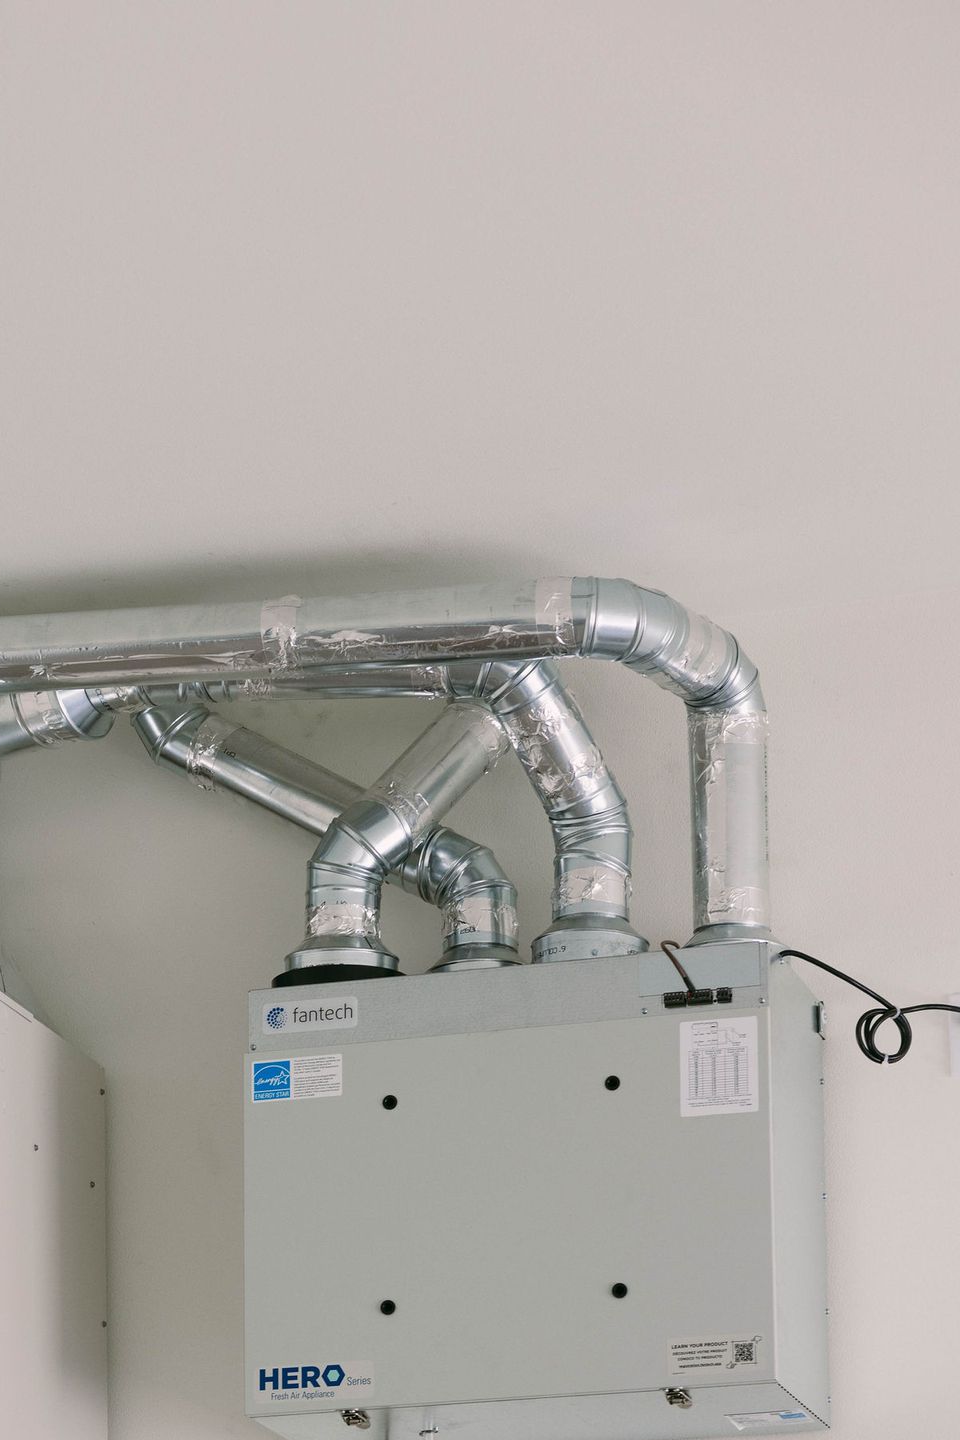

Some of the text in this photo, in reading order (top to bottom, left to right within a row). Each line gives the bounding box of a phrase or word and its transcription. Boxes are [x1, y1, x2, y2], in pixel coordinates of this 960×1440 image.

[293, 1003, 353, 1023] fantech
[254, 1090, 290, 1100] ENERGY STAR
[259, 1364, 372, 1391] HERO Series
[270, 1390, 335, 1401] Fresh Air Appliance
